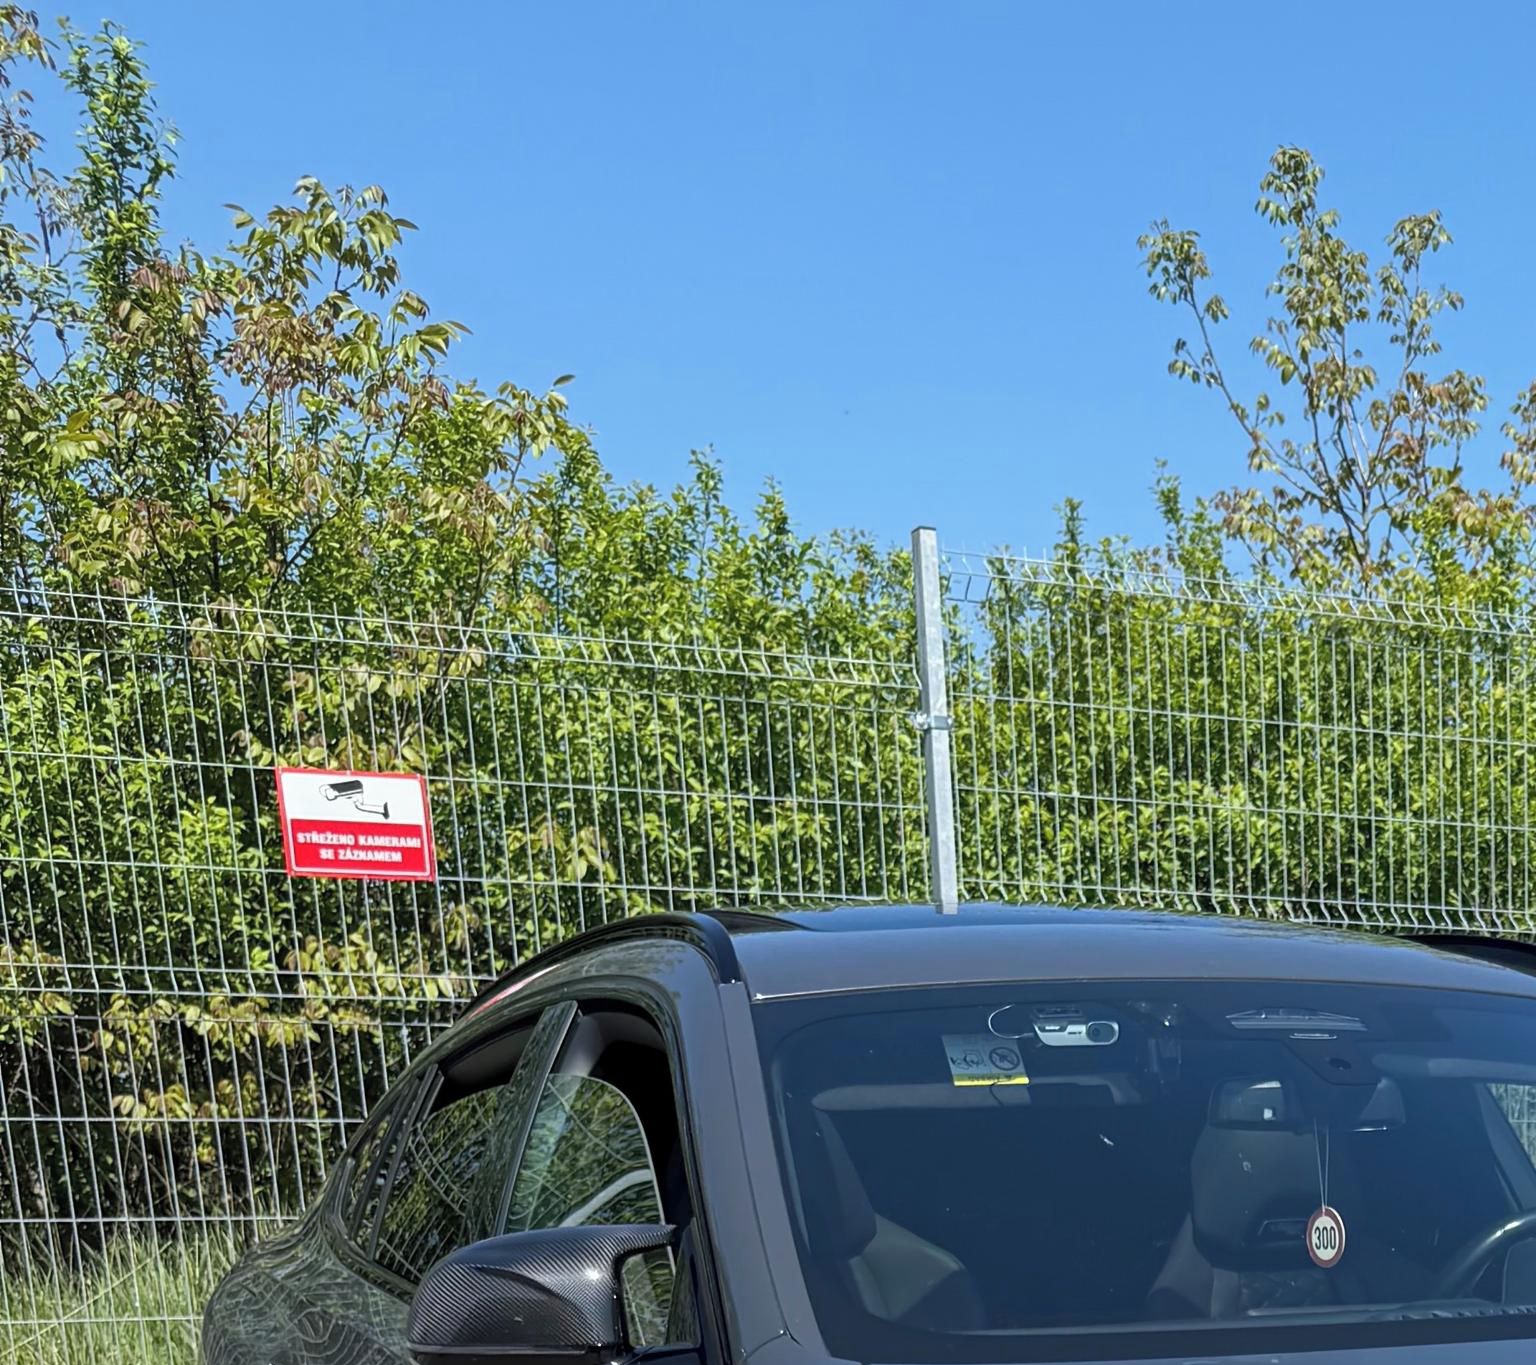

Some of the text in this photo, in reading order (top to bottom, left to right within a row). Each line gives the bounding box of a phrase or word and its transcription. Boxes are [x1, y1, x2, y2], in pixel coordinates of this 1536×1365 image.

[297, 831, 421, 848] STŘEŽENO KAMERAMI
[320, 847, 402, 862] SE ZÁZNAMEM
[1314, 1226, 1337, 1250] 300
